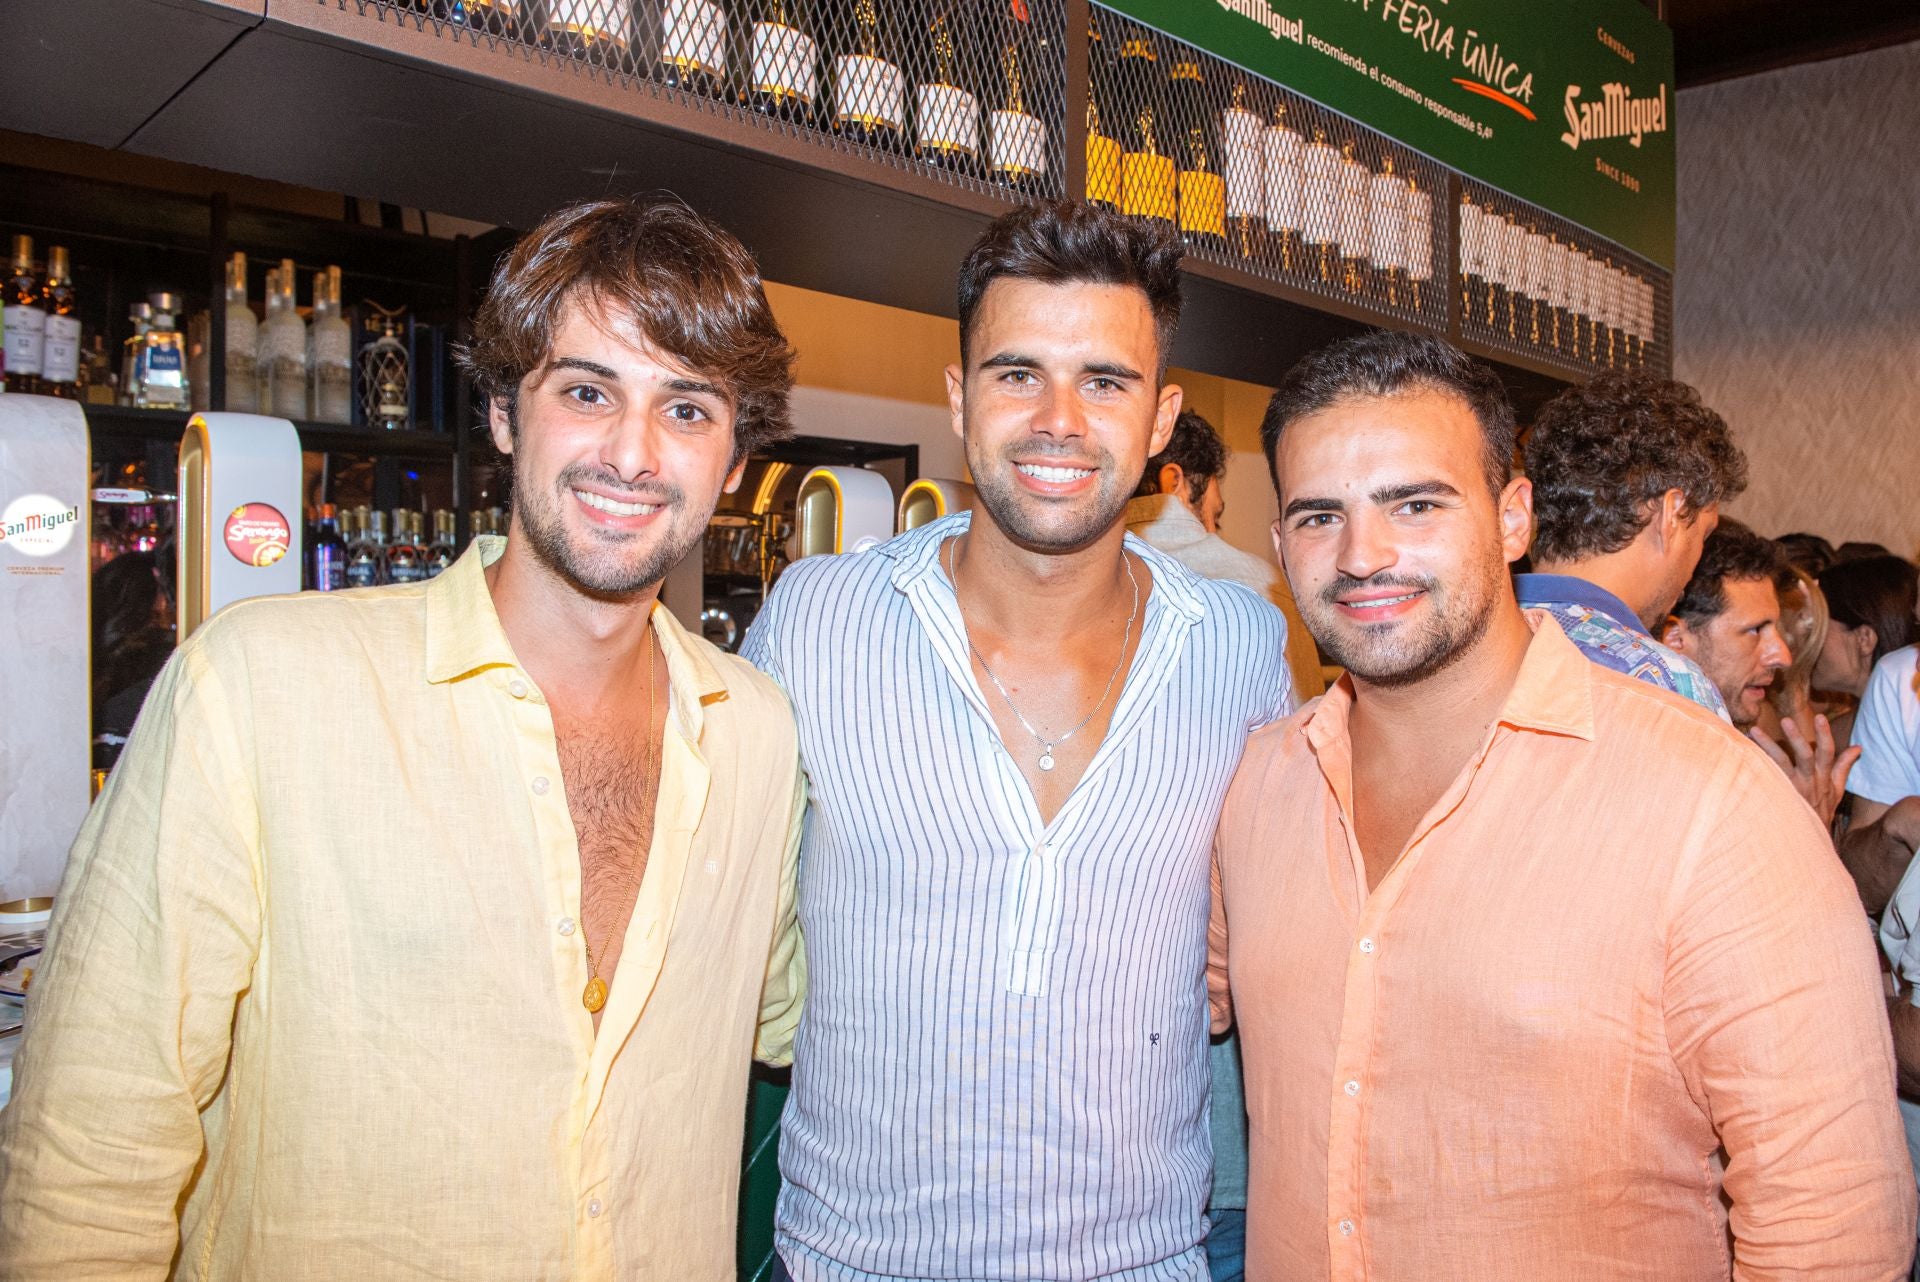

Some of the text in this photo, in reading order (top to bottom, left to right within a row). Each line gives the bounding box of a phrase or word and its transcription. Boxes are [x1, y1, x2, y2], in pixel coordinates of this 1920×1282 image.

[1383, 0, 1454, 59] FERIA
[1307, 33, 1368, 75] recomienda
[1369, 66, 1379, 83] el
[1380, 73, 1423, 105] consumo
[1424, 97, 1476, 133] responsable
[1561, 82, 1667, 150] SanMiguel
